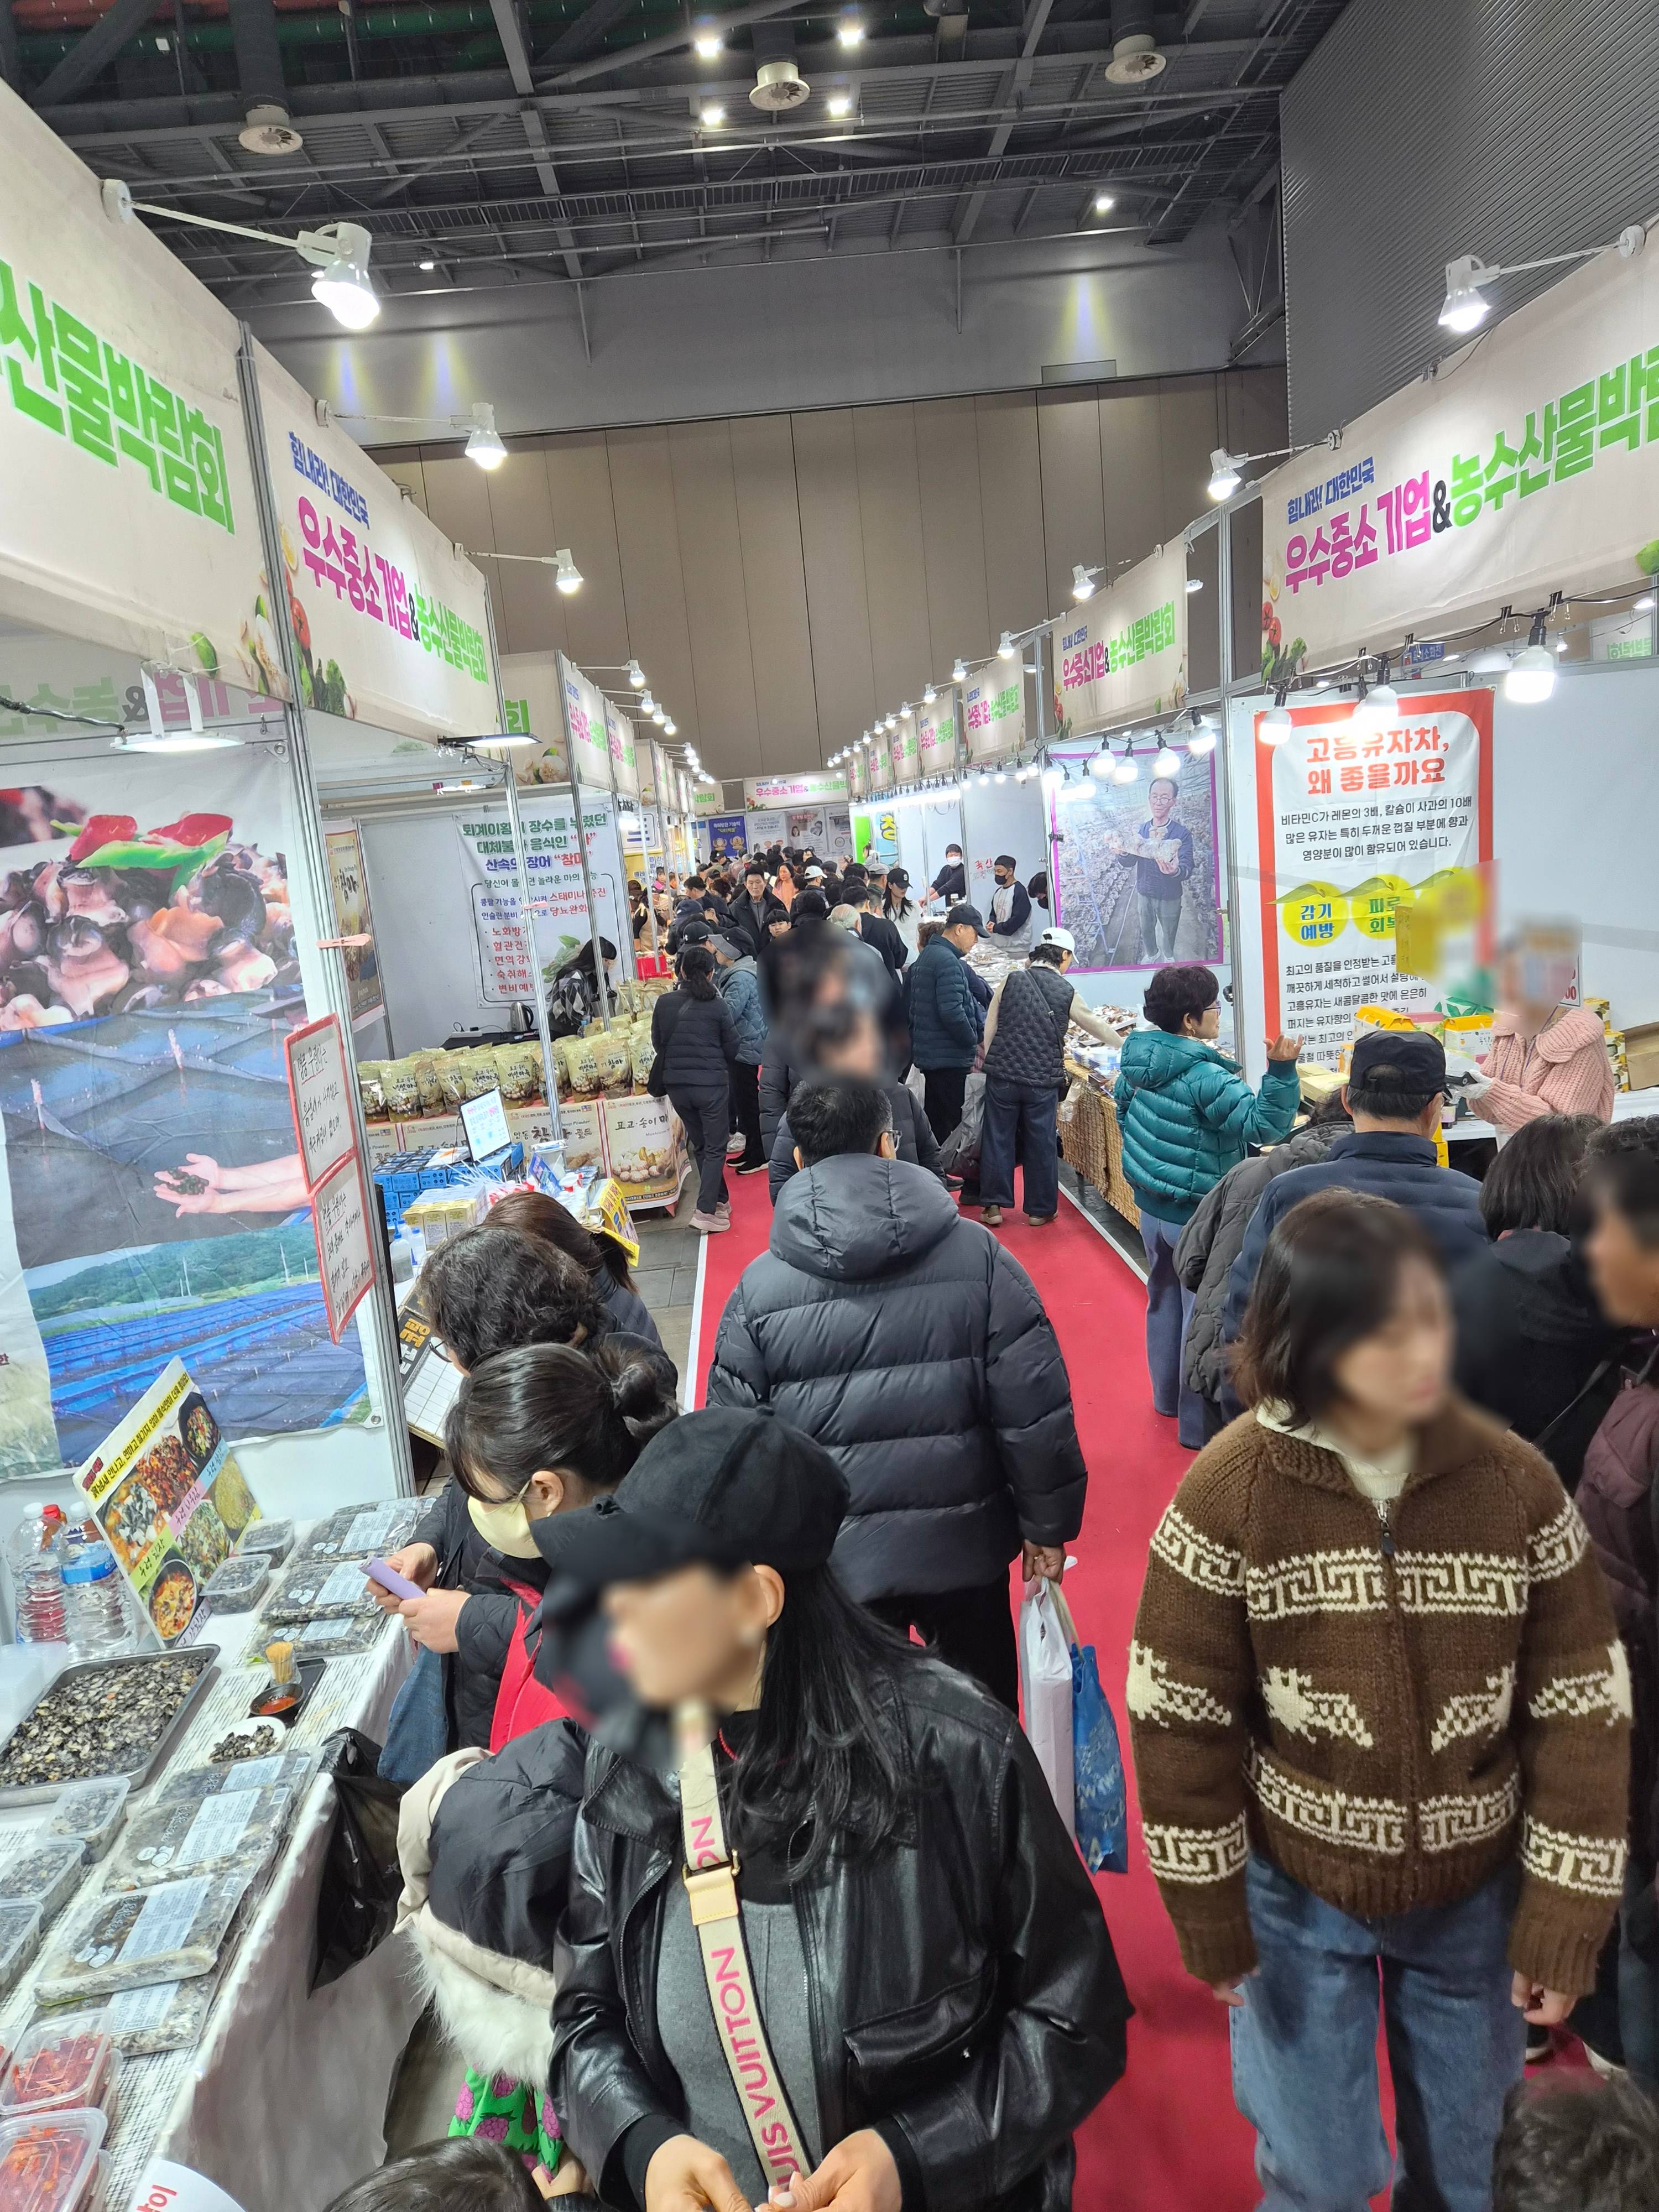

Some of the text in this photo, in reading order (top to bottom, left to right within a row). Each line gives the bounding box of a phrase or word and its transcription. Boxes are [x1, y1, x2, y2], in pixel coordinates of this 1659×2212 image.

[1285, 345, 1659, 594] 우수중소기업&농수산물박
[330, 469, 370, 530] 대한민국
[1287, 456, 1375, 525] 힘내라! 대한민국
[1307, 758, 1446, 795] 왜 좋을까요
[1281, 796, 1473, 826] 비타민C가 레몬의 3배, 칼슘이 사과의 10배
[528, 817, 567, 832] 장수를
[1285, 815, 1468, 844] 많은 유자는 특히 두꺼운 껍질 부분에 향과
[477, 839, 527, 854] 대체불
[530, 836, 567, 851] 음식인
[1302, 836, 1452, 861] 영양분이 많이 함유되어 있습니다.
[526, 855, 551, 869] 장어
[484, 879, 509, 889] 당신이
[538, 875, 561, 885] 놀라운
[564, 873, 580, 881] 마의
[495, 896, 516, 906] 기능을
[550, 890, 585, 901] 스태미나
[482, 911, 503, 921] 인슐린
[504, 910, 518, 919] 분비
[550, 904, 588, 917] 당뇨완화
[1301, 903, 1334, 941] 감기 예방
[493, 941, 527, 952] 혈관건
[1286, 964, 1312, 976] 최고의
[1315, 961, 1342, 973] 품질을
[1344, 957, 1380, 970] 인정받는
[1286, 980, 1322, 994] 깨끗하게
[1324, 977, 1360, 990] 세척하고
[1361, 974, 1388, 987] 썰어서
[1287, 988, 1427, 1012] 고흥유자는 새콤달콤한 맛에 은은히
[1287, 1013, 1351, 1030] 퍼지는 유자향의
[1318, 1031, 1344, 1044] 최고의
[711, 1947, 776, 2120] VUITTON
